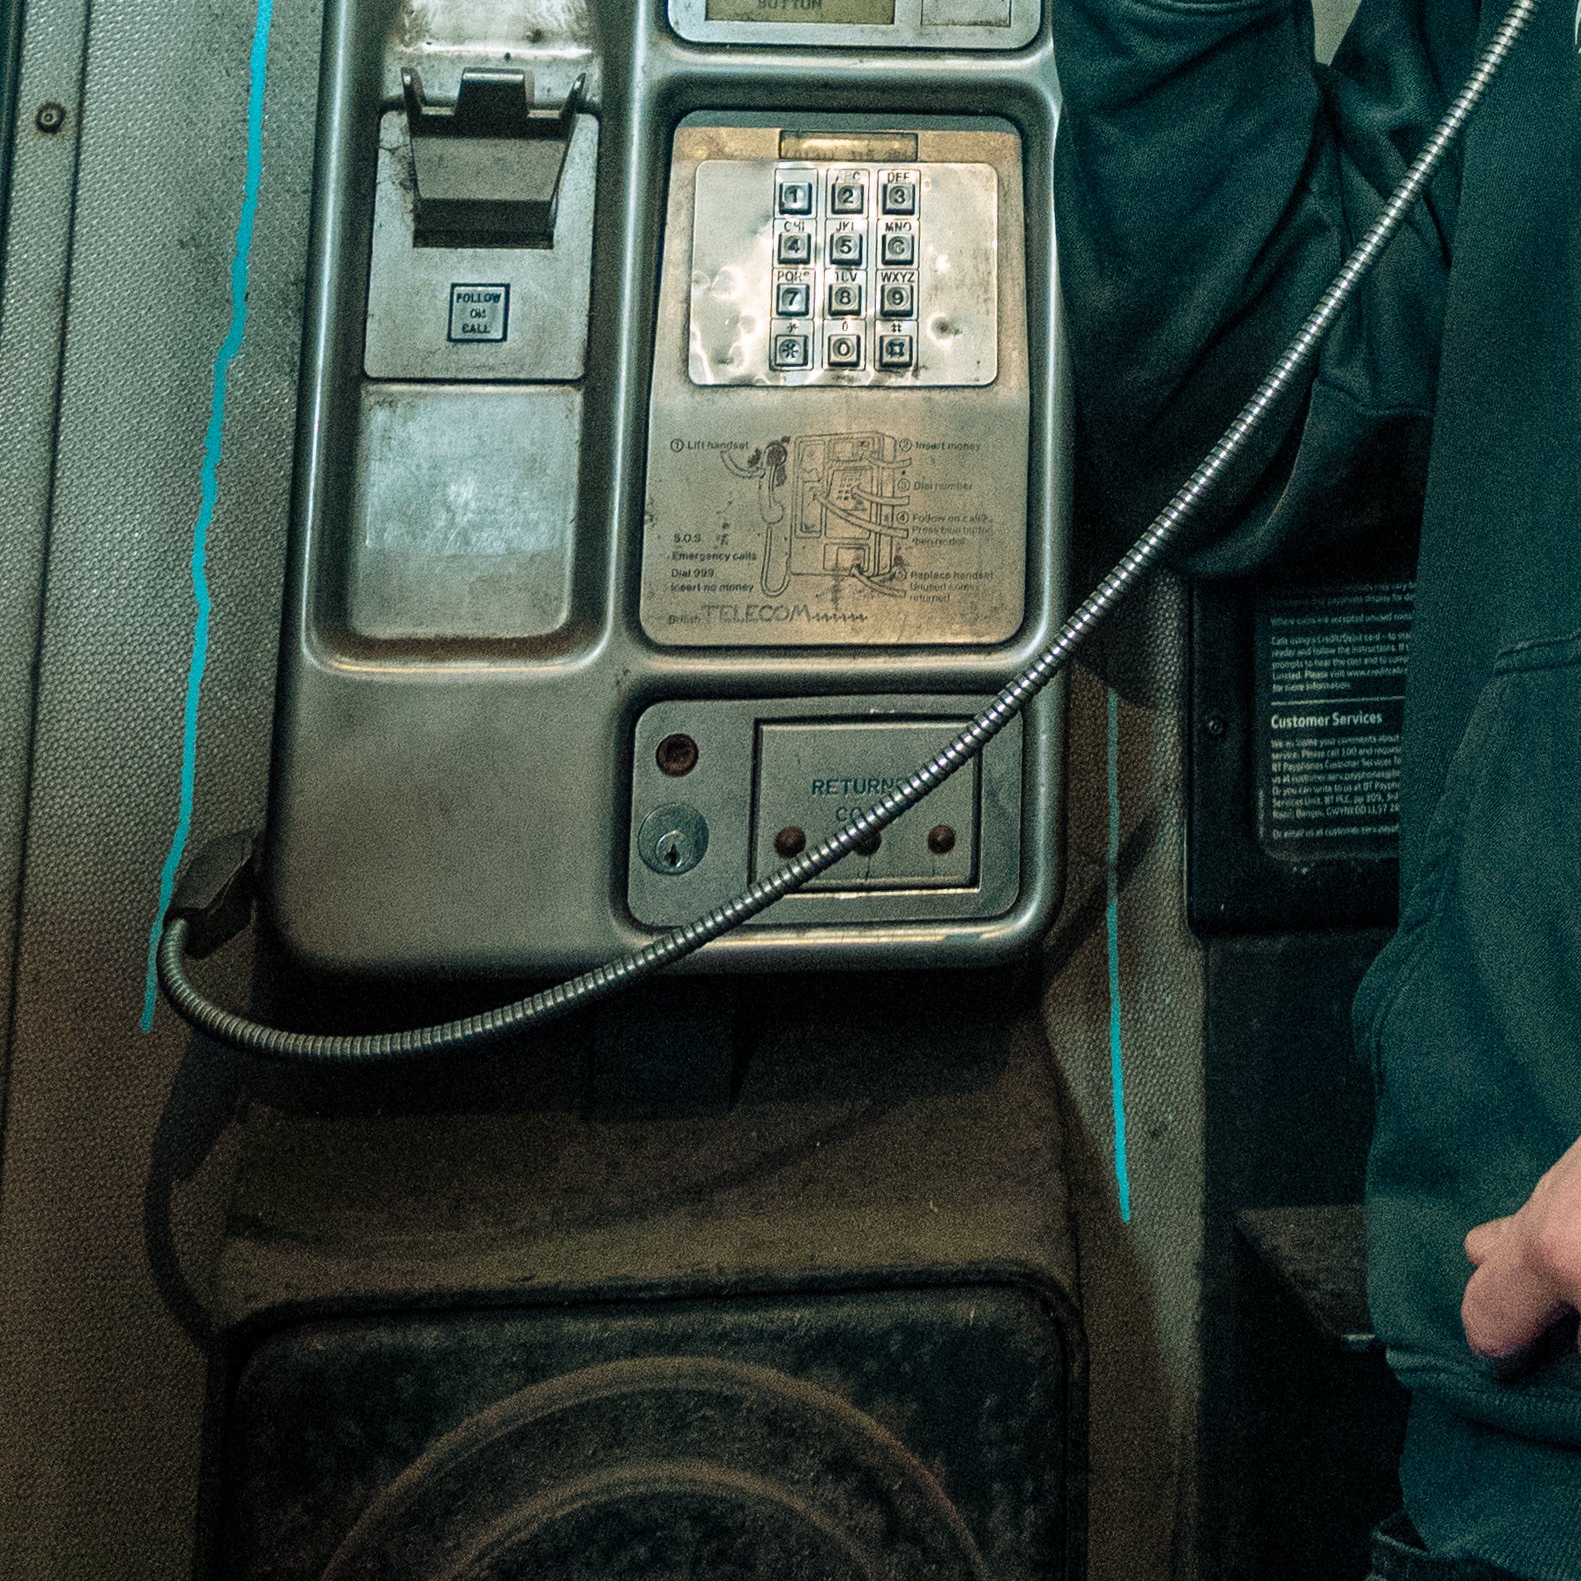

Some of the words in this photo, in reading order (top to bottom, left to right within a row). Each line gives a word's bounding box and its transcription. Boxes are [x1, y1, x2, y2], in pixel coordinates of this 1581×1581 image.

[789, 189, 797, 203] 1
[842, 190, 853, 203] 2
[894, 190, 905, 204] 3
[788, 239, 800, 252] 4
[840, 240, 852, 254] 5
[881, 272, 915, 283] WXYZ
[456, 293, 502, 303] FOLLOW
[787, 291, 799, 305] 7
[839, 290, 851, 305] 8
[892, 291, 904, 305] 9
[470, 308, 486, 318] ON
[462, 323, 491, 334] CALL
[837, 343, 850, 357] 0
[701, 604, 811, 622] TELECOM
[1271, 715, 1329, 729] Customer
[1332, 710, 1383, 726] Services
